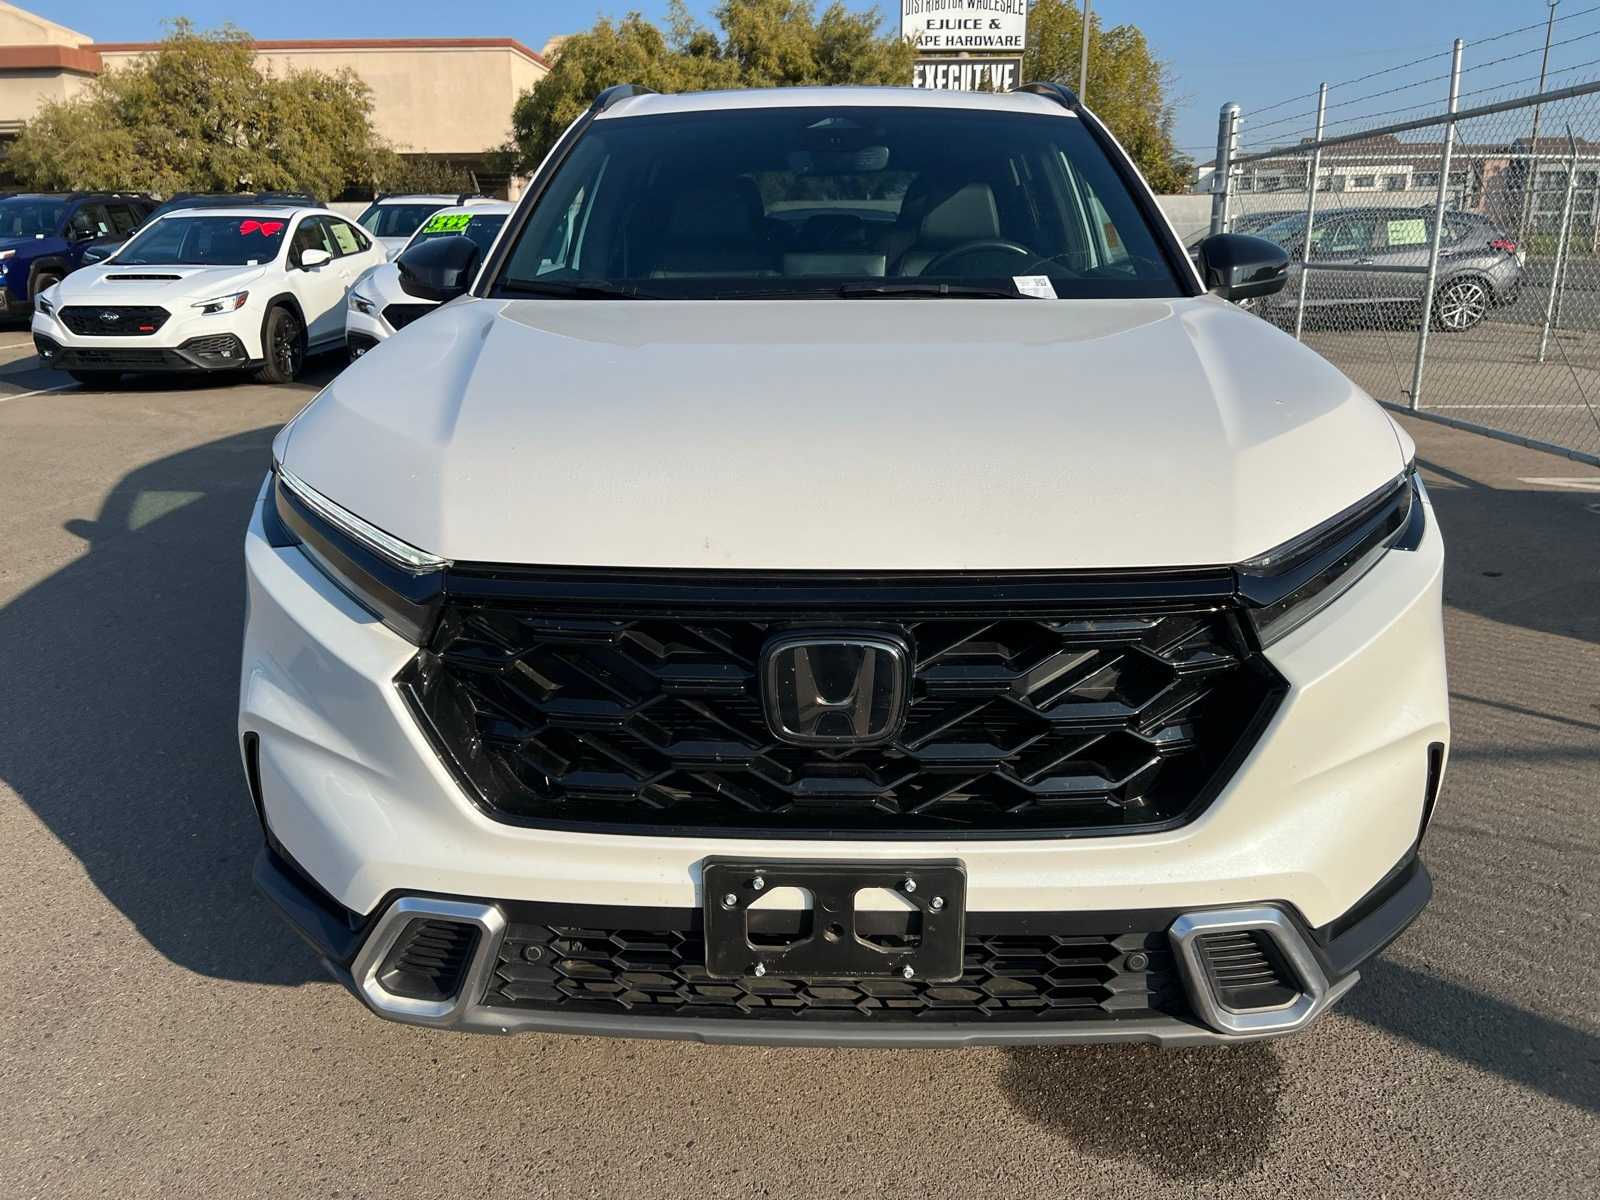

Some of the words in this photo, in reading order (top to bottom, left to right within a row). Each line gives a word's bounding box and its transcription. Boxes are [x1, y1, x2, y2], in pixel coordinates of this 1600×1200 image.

[966, 0, 1024, 16] WHOLESALE
[926, 18, 982, 30] EJUICE
[989, 18, 1002, 30] &
[945, 35, 1022, 47] HARDWARE
